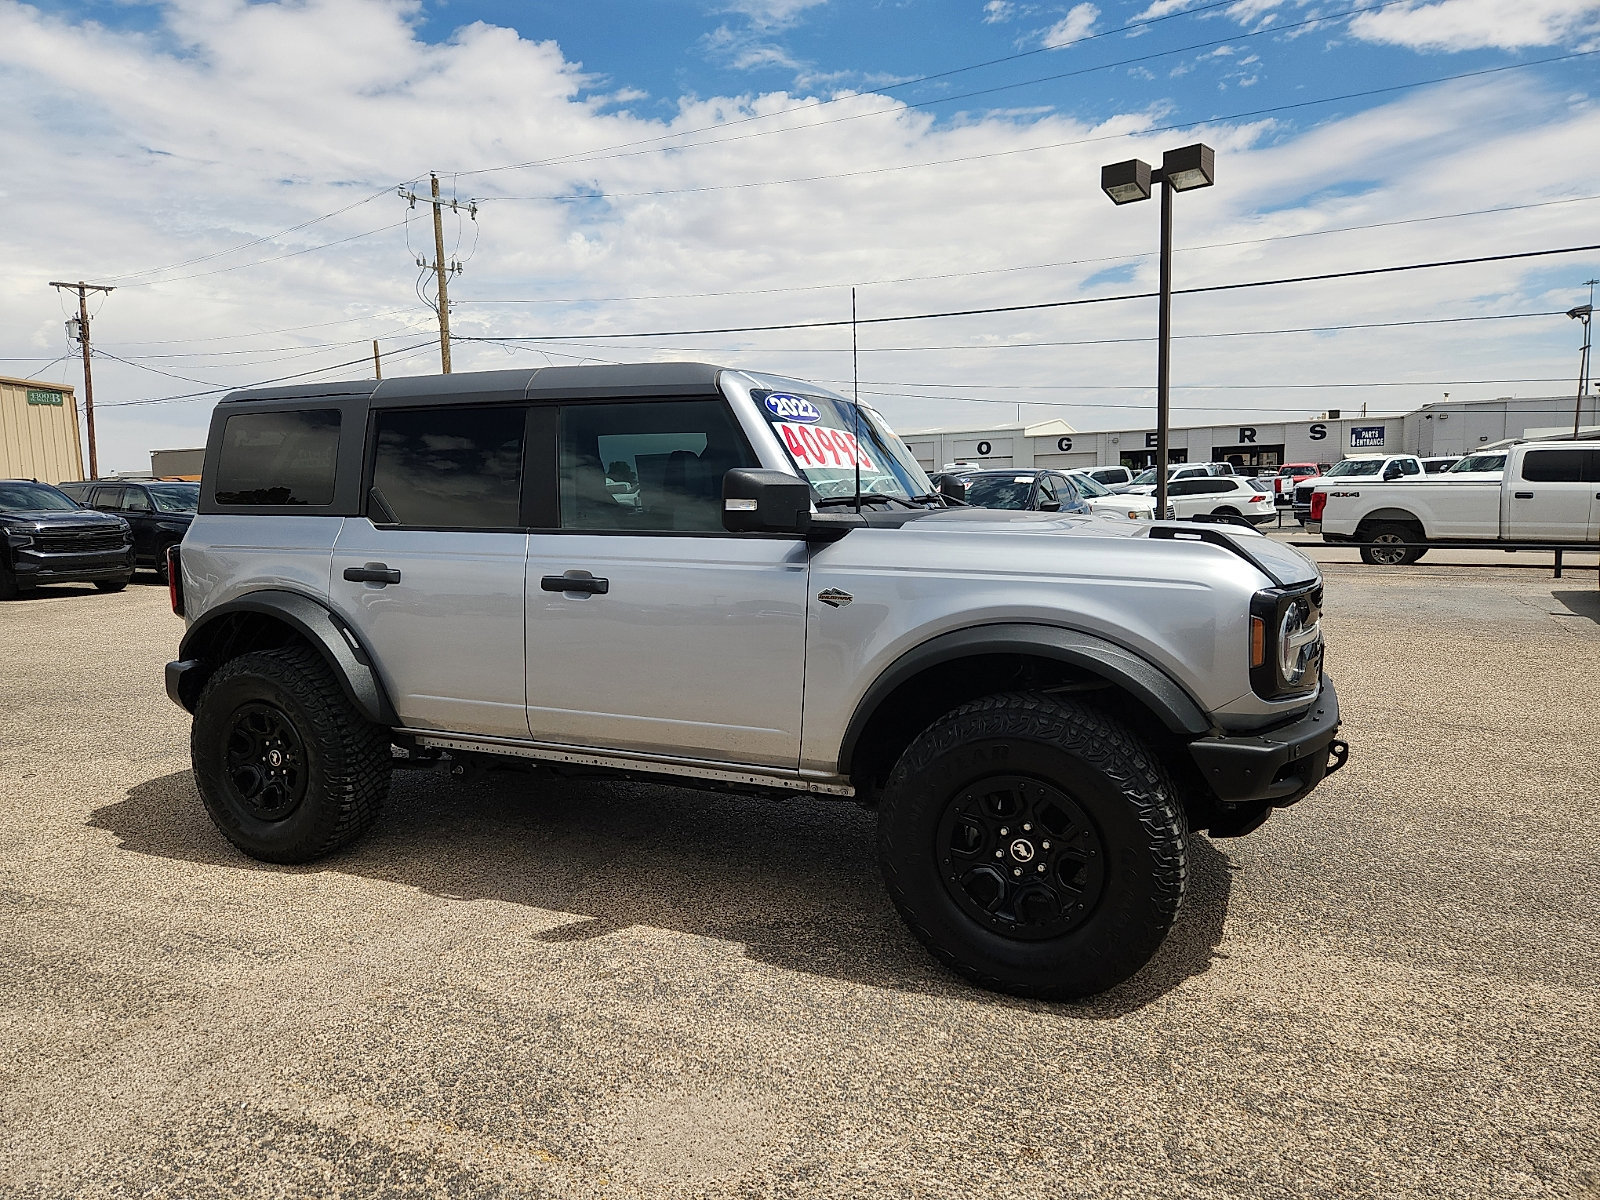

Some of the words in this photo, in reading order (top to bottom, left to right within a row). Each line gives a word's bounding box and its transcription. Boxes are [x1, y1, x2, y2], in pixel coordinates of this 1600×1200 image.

[769, 397, 820, 417] 2022
[781, 424, 872, 469] 40995
[1356, 438, 1384, 446] ENTRANCE
